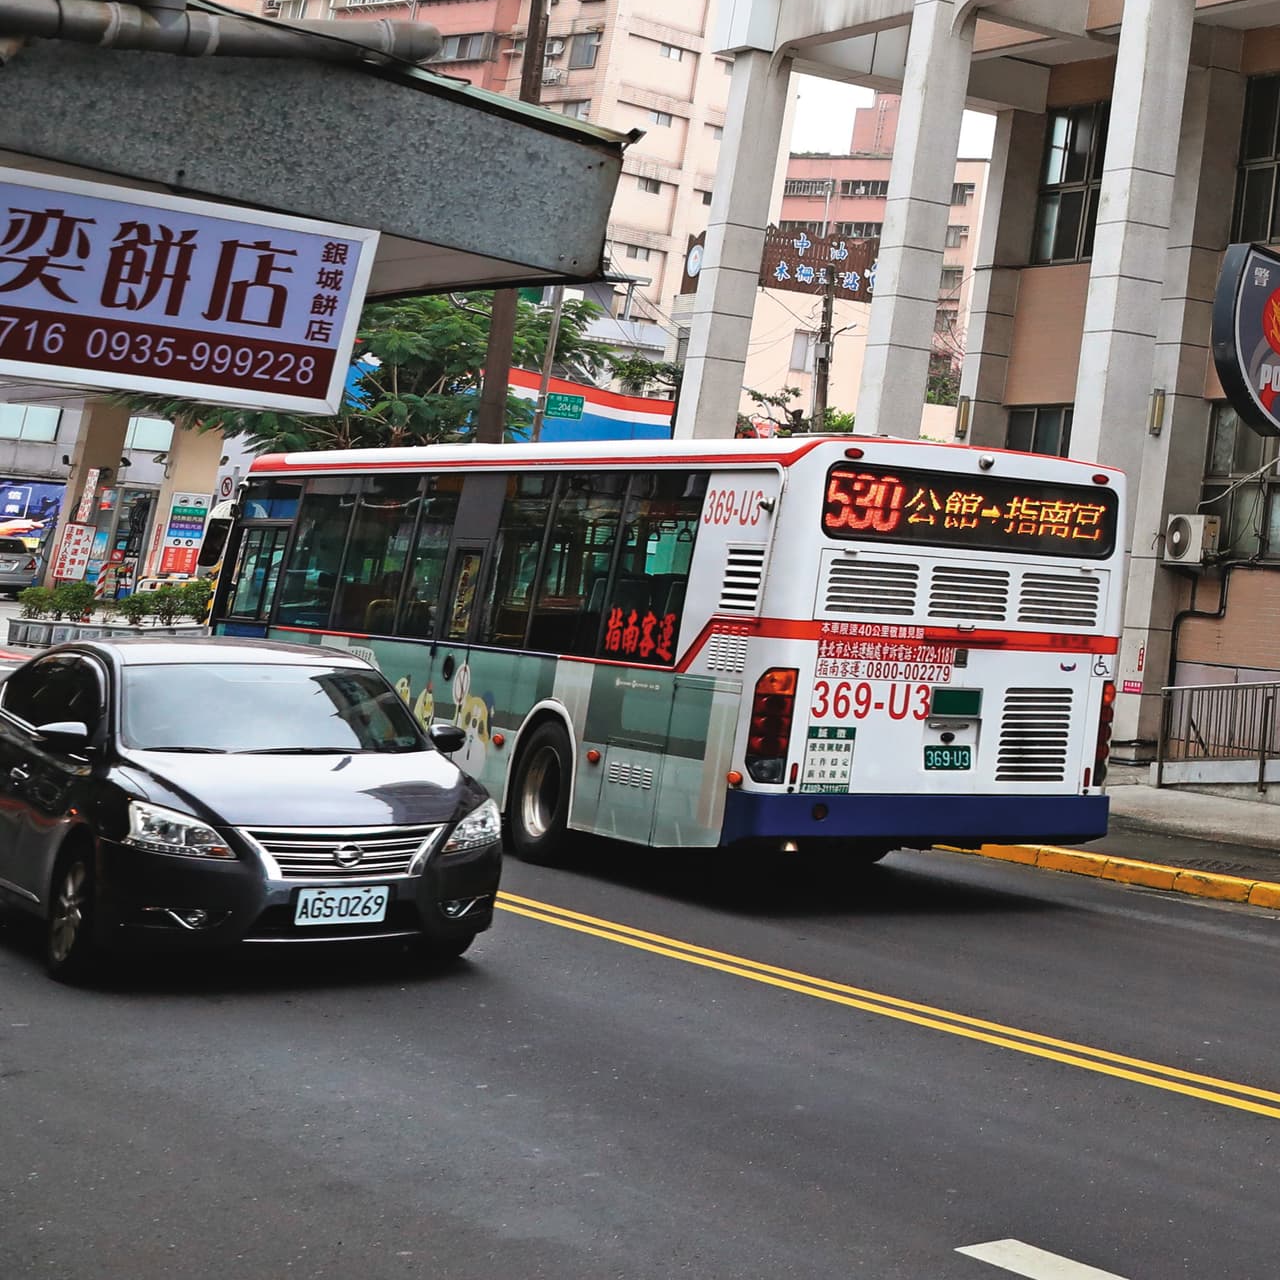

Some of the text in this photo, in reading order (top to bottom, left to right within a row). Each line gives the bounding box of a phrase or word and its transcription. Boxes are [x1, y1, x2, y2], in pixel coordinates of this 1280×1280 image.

[0, 208, 298, 328] 奕餅店
[794, 233, 848, 261] 中油
[305, 241, 349, 344] 銀城餅店
[86, 328, 315, 385] 0935-999228
[704, 488, 764, 527] 369-U3
[825, 470, 902, 532] 530
[605, 607, 676, 662] 指南客運
[811, 681, 930, 720] 369-U3
[926, 750, 970, 768] 369-U3
[298, 895, 385, 919] AGS-0269
